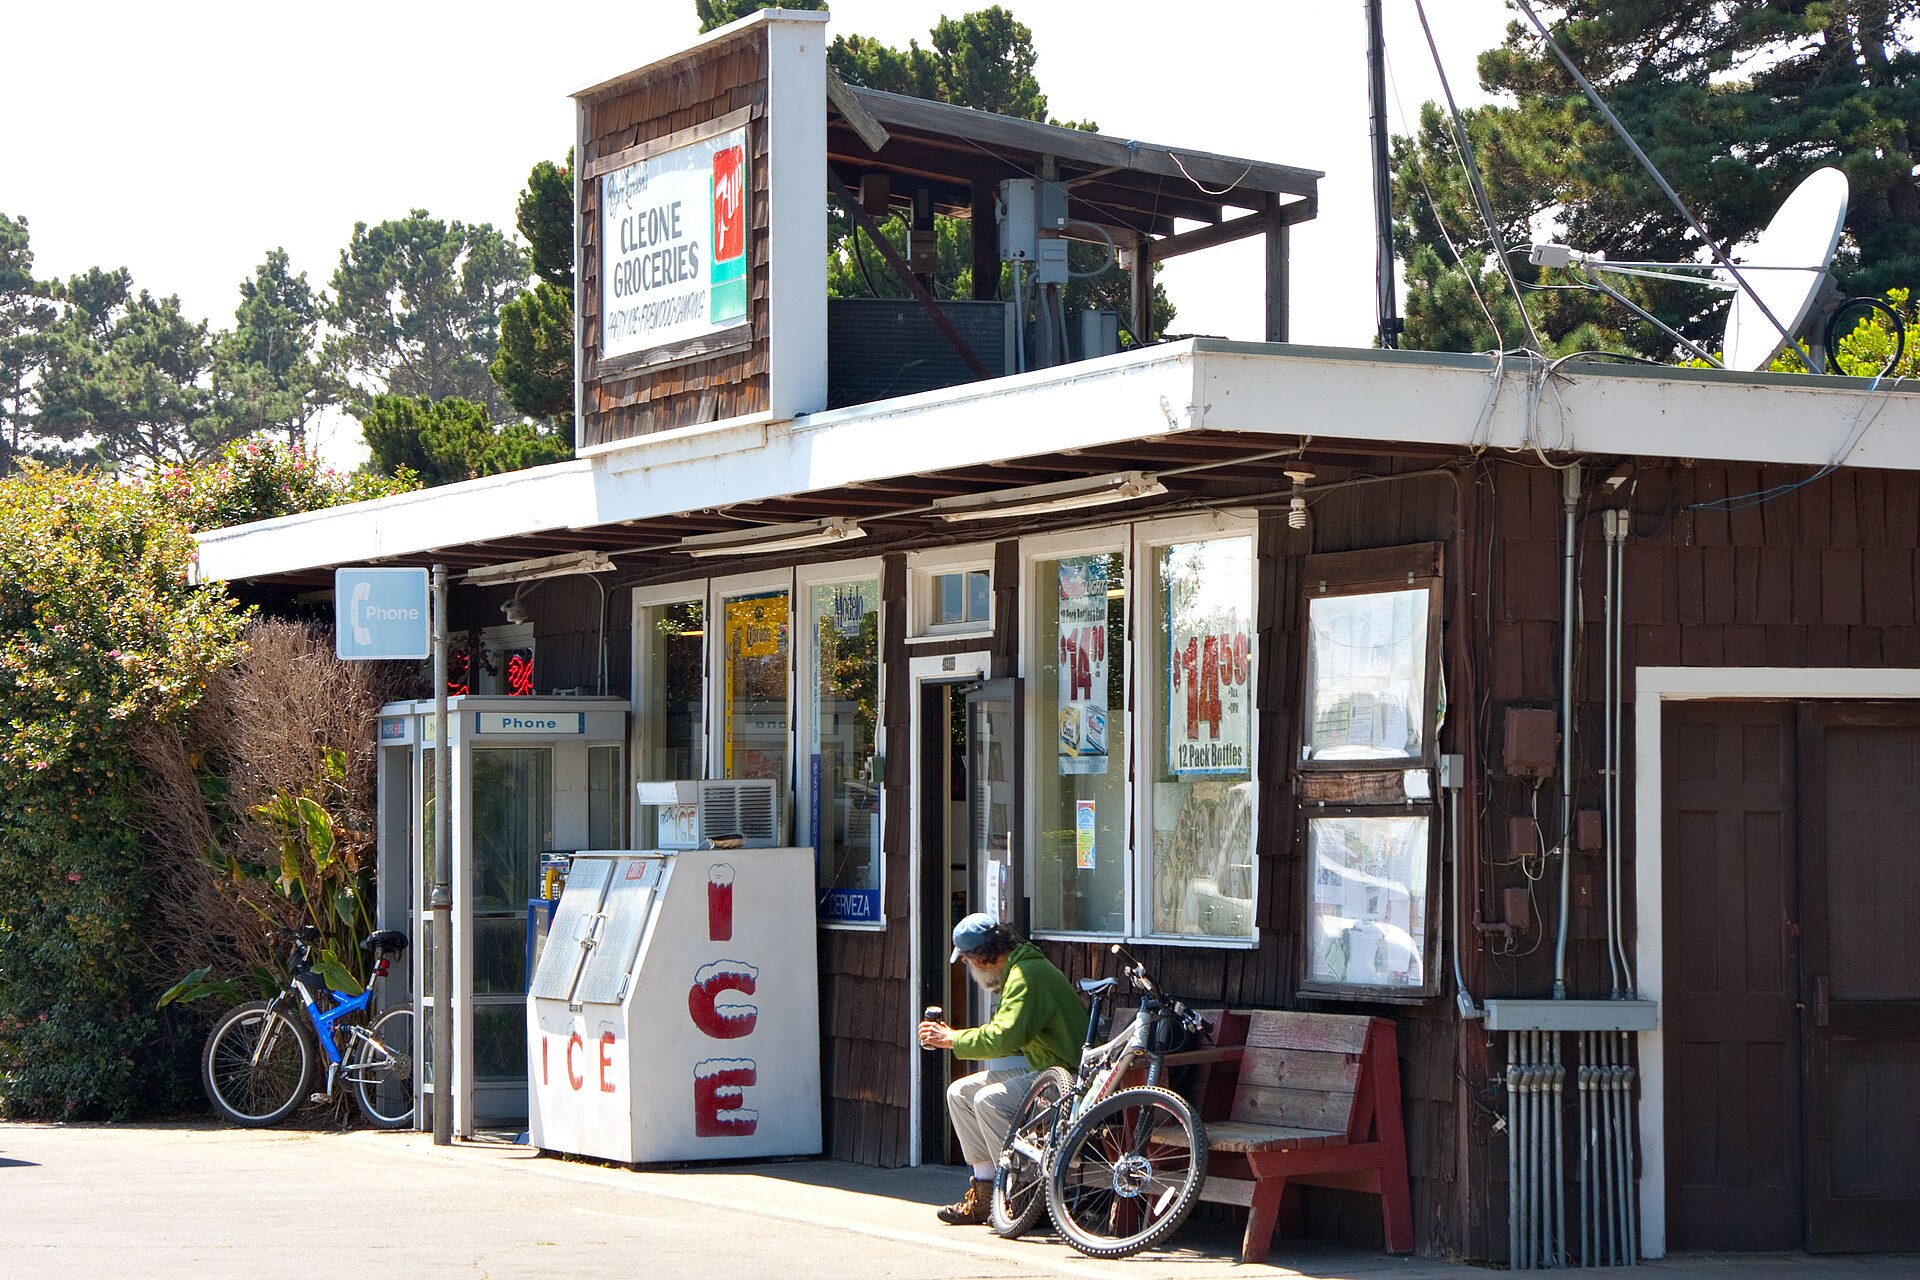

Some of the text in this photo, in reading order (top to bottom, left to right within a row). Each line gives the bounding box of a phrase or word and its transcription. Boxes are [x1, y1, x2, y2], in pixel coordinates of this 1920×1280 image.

[621, 200, 682, 255] CLEONE
[614, 241, 699, 298] GROCERIES
[1086, 579, 1106, 597] LIGHT
[366, 606, 419, 620] Phone
[502, 718, 556, 729] Phone
[1178, 742, 1242, 767] 12 Pack Bottles
[829, 894, 870, 917] CERVEZA
[689, 863, 759, 1138] ICE
[540, 1017, 616, 1093] ICE
